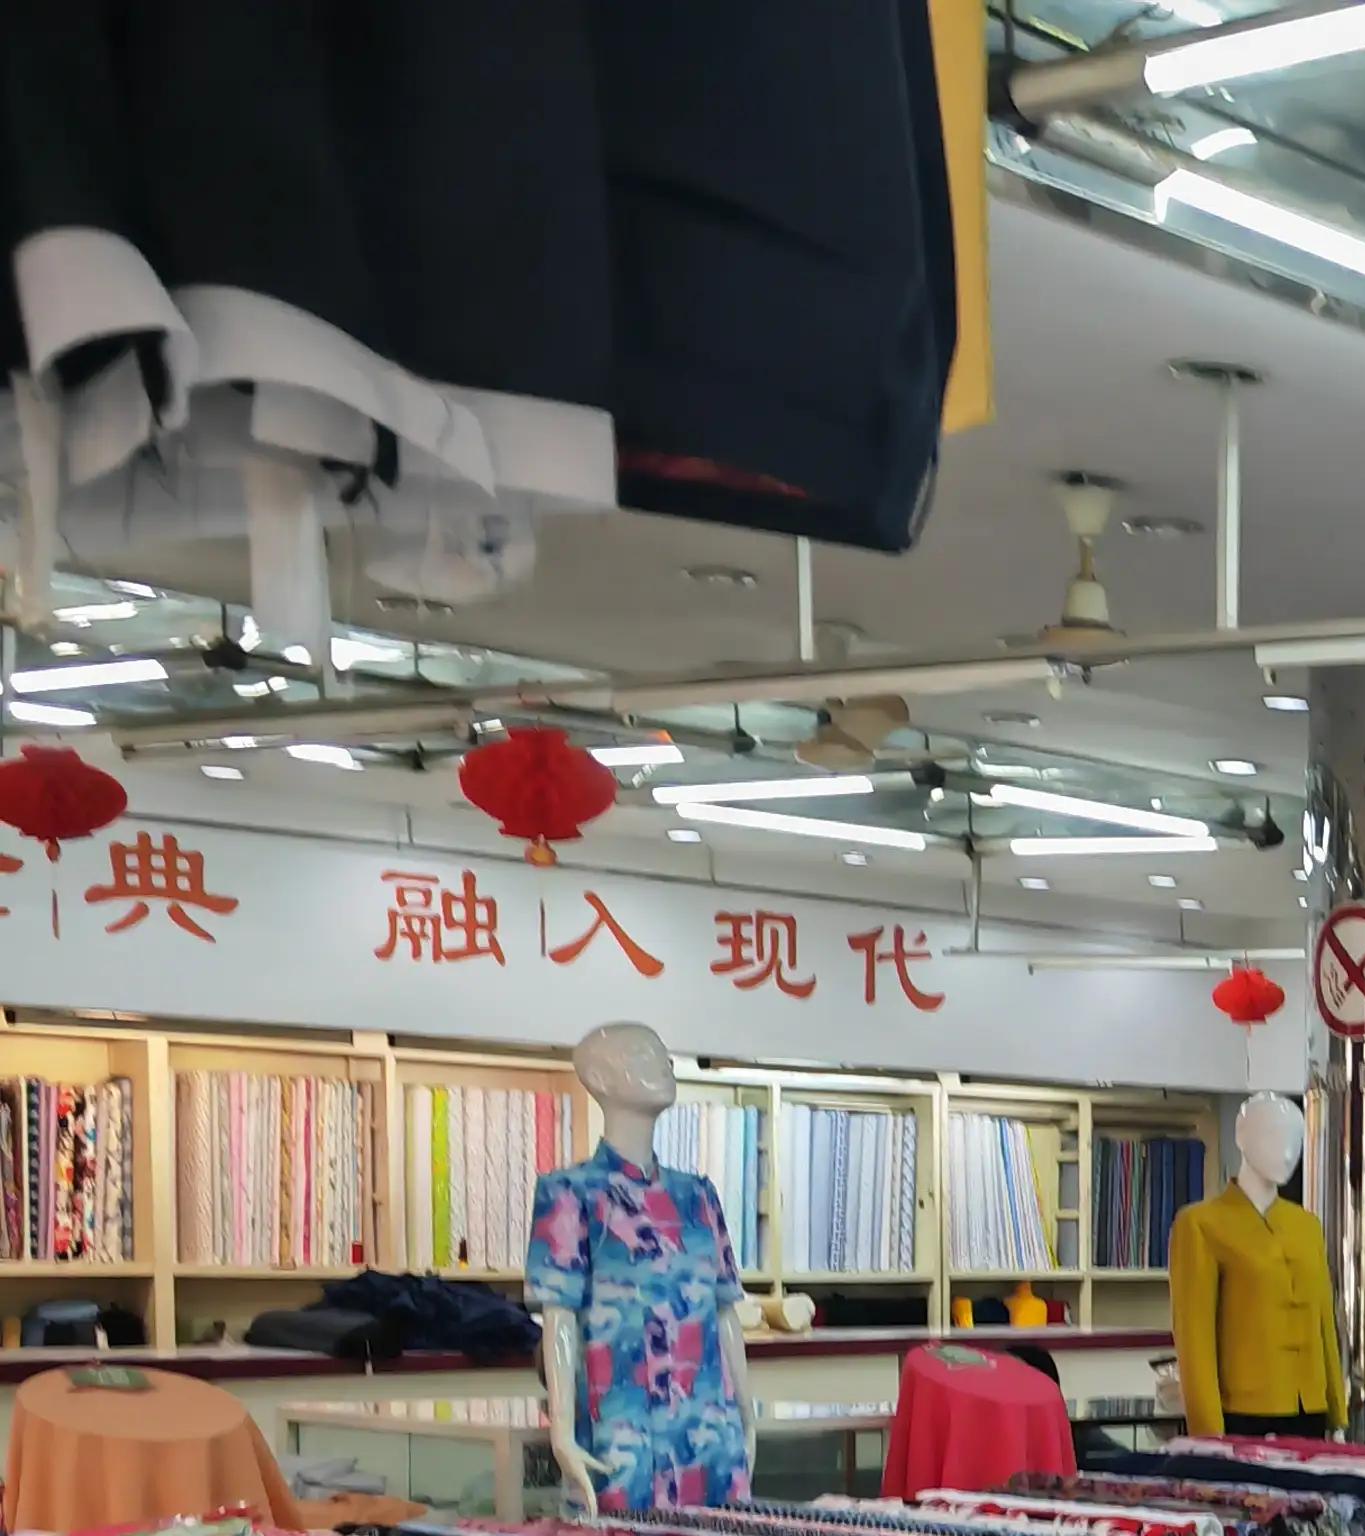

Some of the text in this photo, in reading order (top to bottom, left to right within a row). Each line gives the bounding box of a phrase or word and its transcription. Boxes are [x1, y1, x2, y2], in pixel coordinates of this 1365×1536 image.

[0, 830, 946, 1012] 典 融入现代
